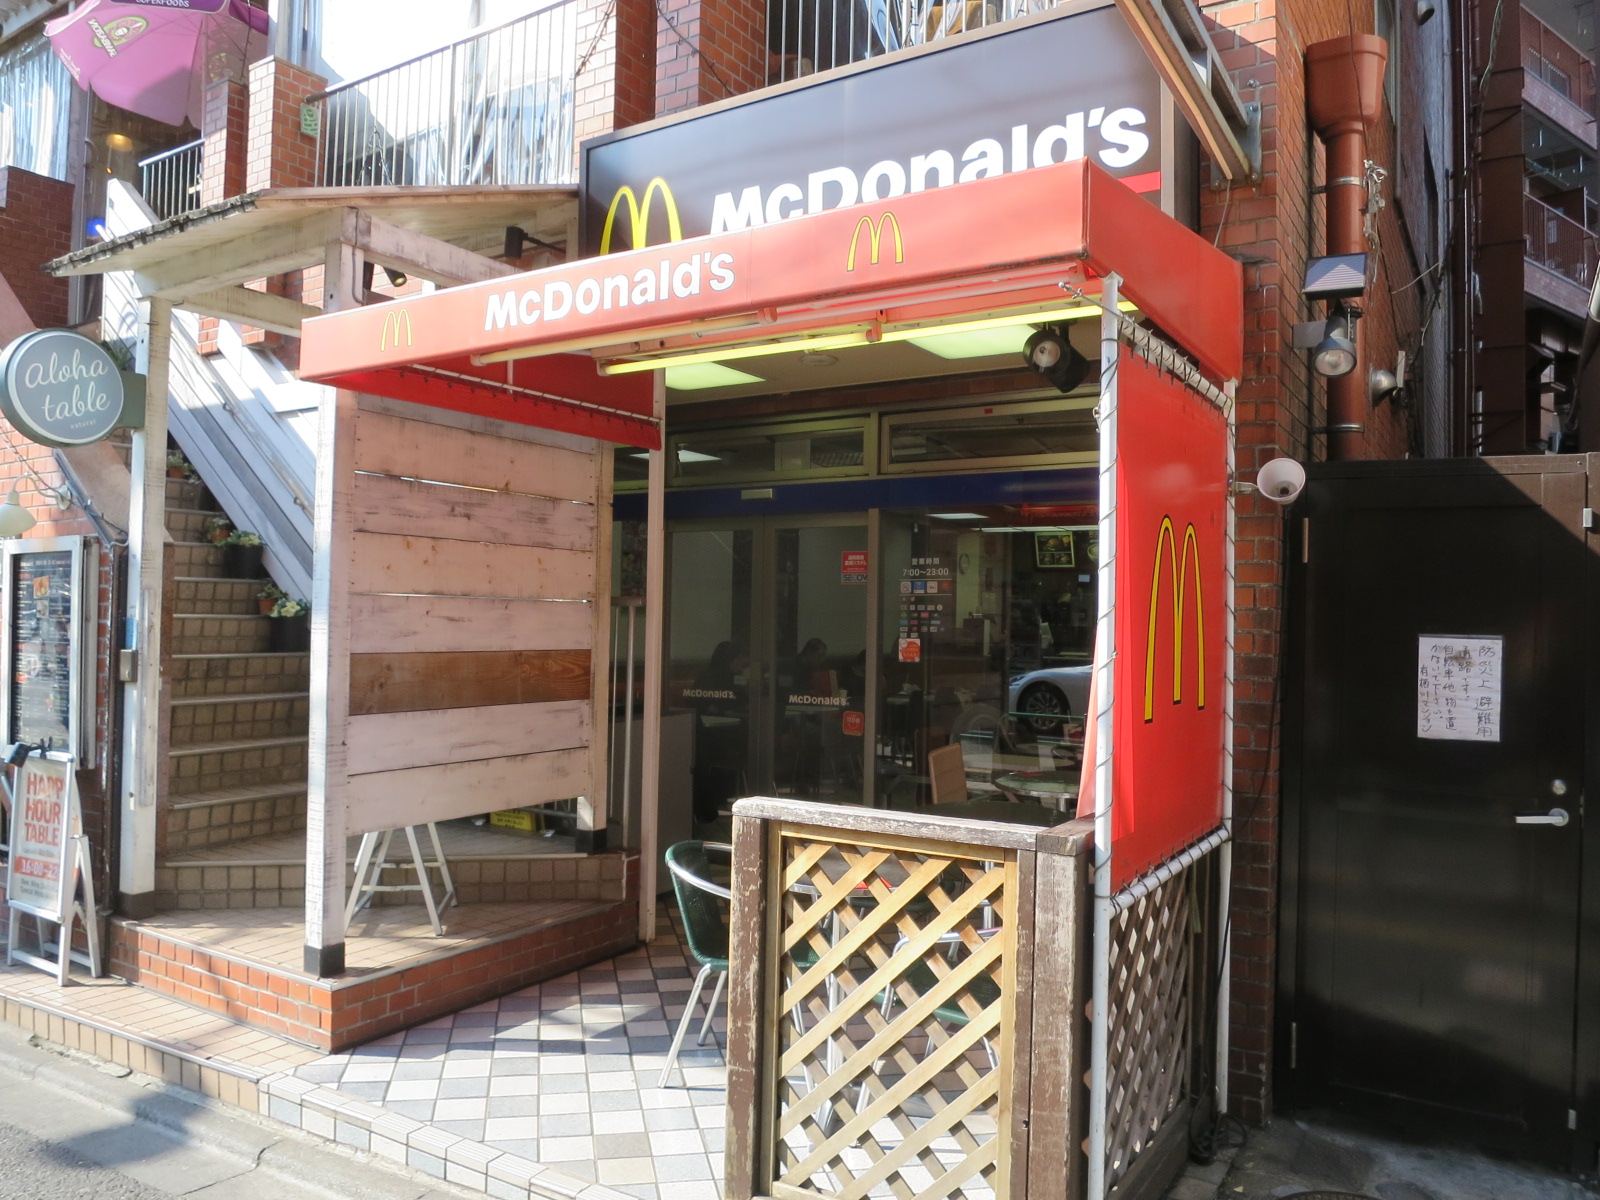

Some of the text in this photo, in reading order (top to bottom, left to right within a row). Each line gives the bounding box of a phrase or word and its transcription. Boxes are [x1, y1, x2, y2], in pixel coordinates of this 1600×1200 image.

[710, 105, 1150, 233] McDonald's
[483, 251, 736, 332] McDonald's
[25, 348, 108, 389] aloha
[41, 381, 110, 422] table
[911, 557, 940, 566] 営業時間
[1473, 645, 1496, 738] 防災上避難用
[25, 797, 62, 825] HOUR
[24, 821, 60, 847] TABLE
